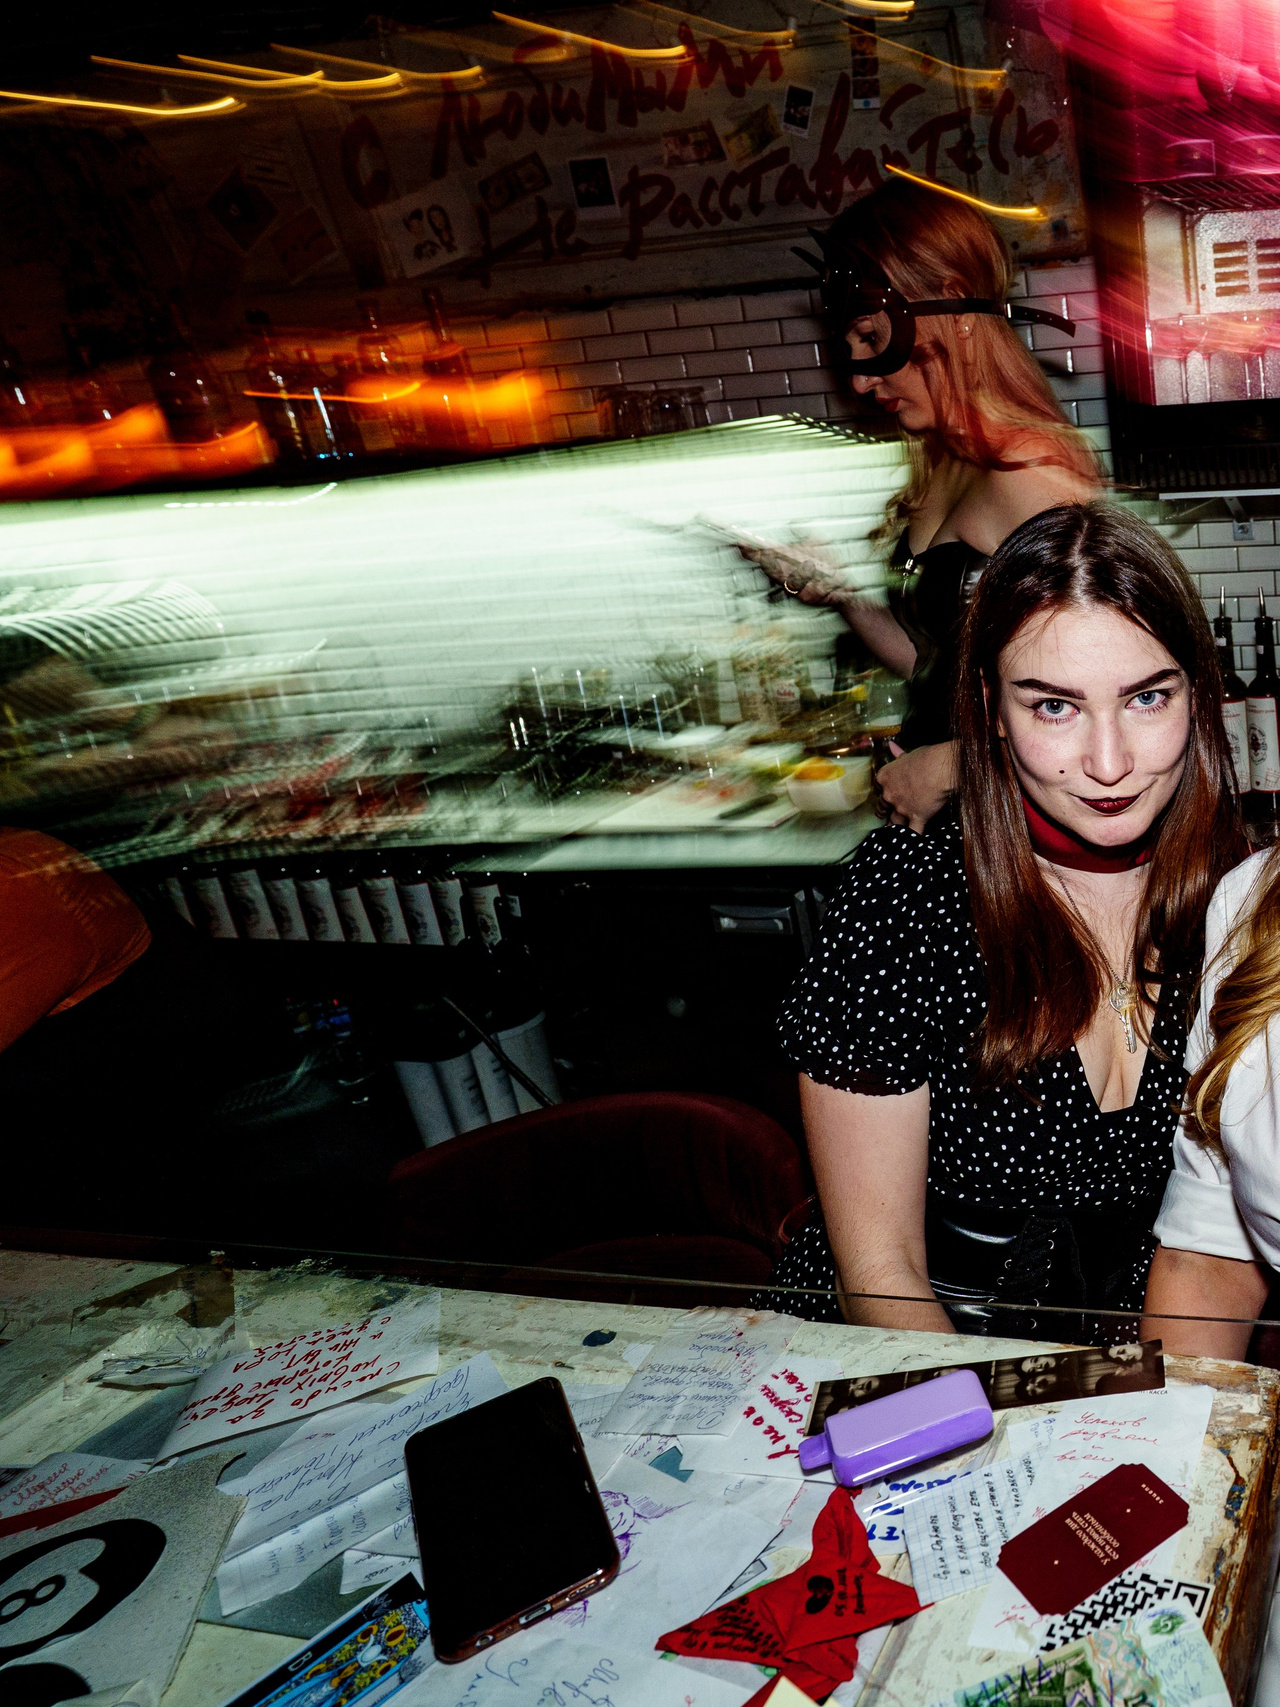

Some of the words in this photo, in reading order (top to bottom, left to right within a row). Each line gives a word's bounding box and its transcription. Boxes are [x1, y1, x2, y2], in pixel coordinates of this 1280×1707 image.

[1064, 1518, 1080, 1530] дня
[1072, 1511, 1089, 1529] стать
[1084, 1512, 1120, 1548] особенным
[1086, 1526, 1106, 1547] повод
[1076, 1529, 1106, 1559] каждого
[1104, 1544, 1120, 1561] есть
